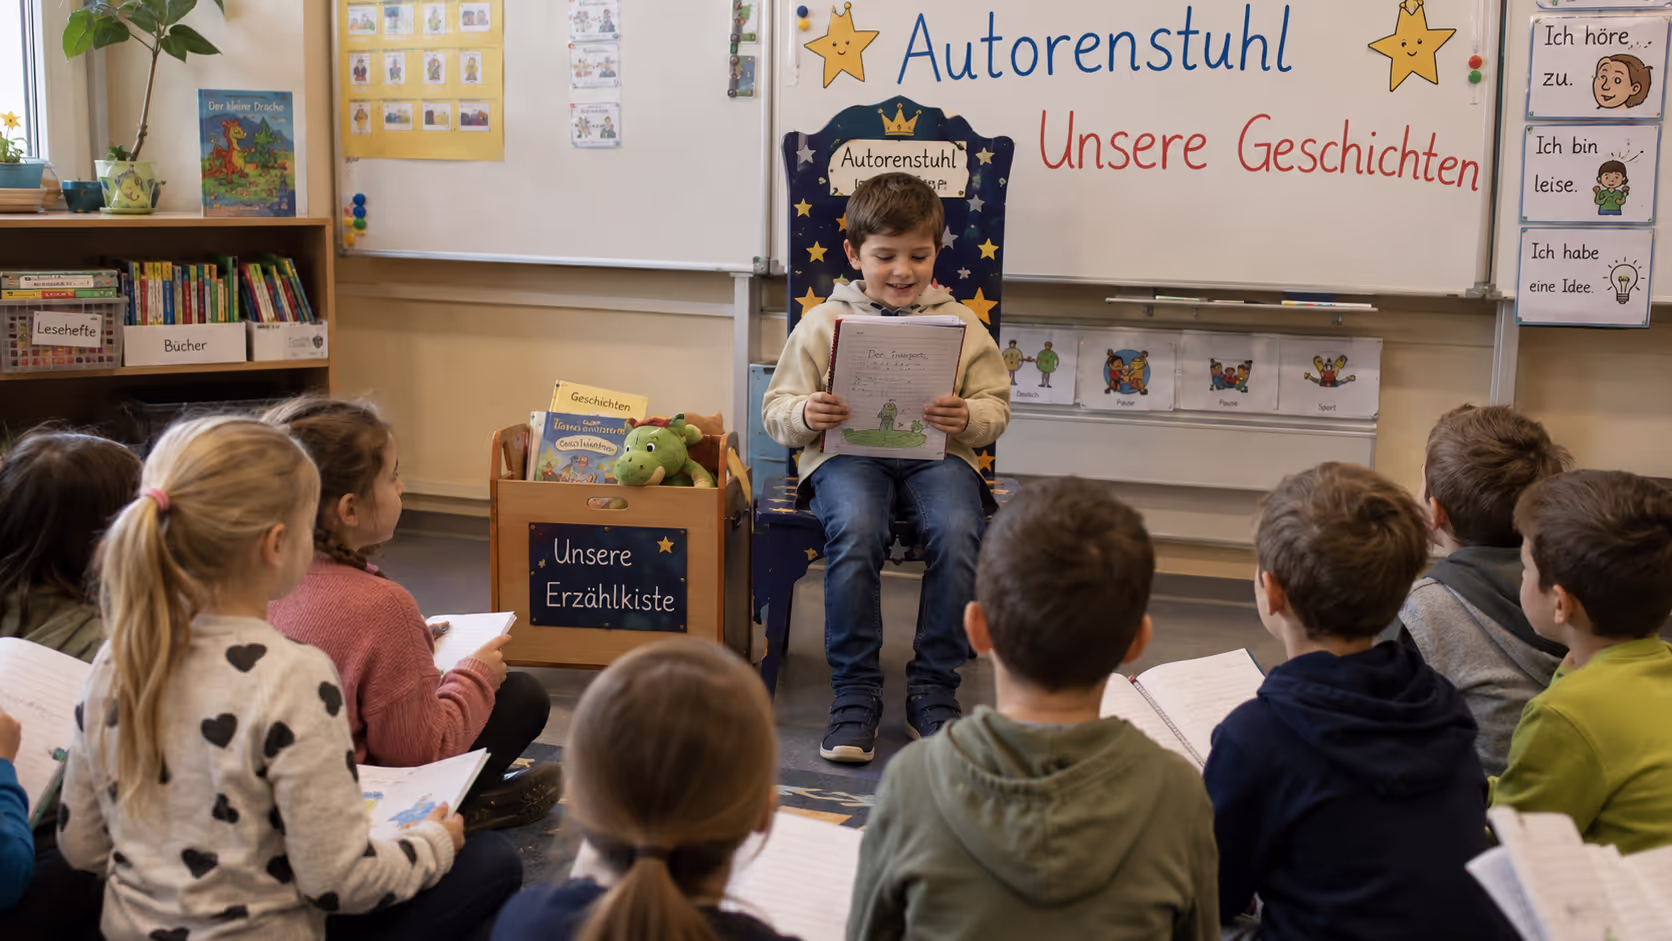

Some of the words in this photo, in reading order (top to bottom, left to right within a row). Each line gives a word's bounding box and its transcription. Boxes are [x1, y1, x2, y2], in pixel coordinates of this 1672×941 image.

[898, 4, 1293, 84] Autorenstuhl
[1544, 24, 1574, 46] Ich
[1584, 24, 1629, 46] höre
[1542, 72, 1573, 87] zu.
[1040, 110, 1208, 170] Unsere
[1237, 113, 1480, 191] Geschichten
[1535, 135, 1562, 155] Ich
[1572, 135, 1598, 155] bin
[841, 146, 956, 169] Autorenstuhl
[1534, 174, 1578, 193] leise.
[1531, 242, 1555, 260] Ich
[1563, 243, 1599, 260] habe
[1529, 280, 1556, 293] eine
[1562, 278, 1595, 293] Idee.
[37, 321, 97, 337] Lesehefte
[164, 338, 208, 353] Bücher
[571, 391, 631, 412] Geschichten
[1116, 399, 1135, 407] Pause
[1219, 399, 1238, 407] Pause
[1318, 403, 1337, 412] Sport
[554, 537, 633, 567] Unsere
[546, 581, 675, 612] Erzählkiste
